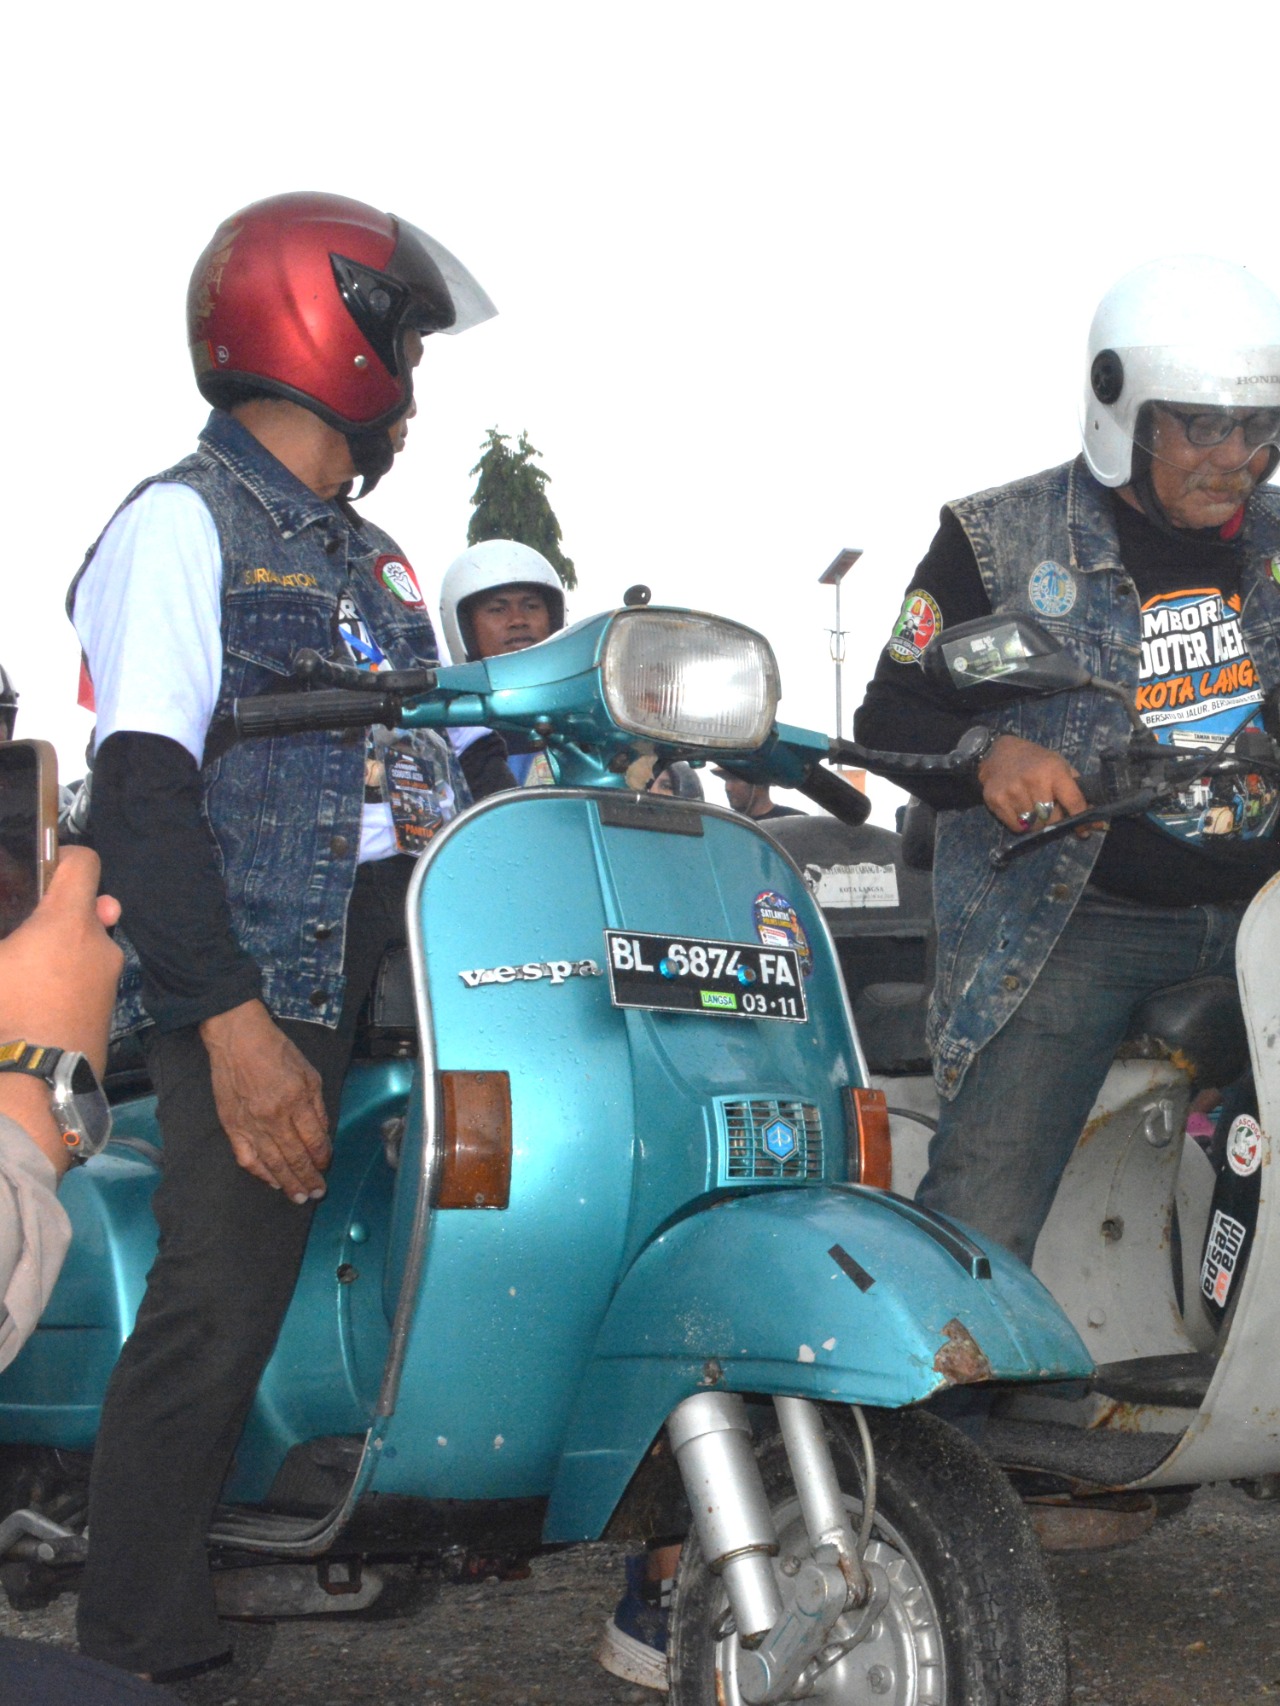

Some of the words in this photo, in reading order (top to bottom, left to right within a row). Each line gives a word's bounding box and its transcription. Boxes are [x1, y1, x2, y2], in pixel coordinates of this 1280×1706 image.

[1135, 675, 1195, 711] KOTA
[1200, 659, 1259, 698] LANG
[611, 937, 654, 972] BL
[667, 943, 745, 979] 6874
[759, 953, 796, 987] FA
[702, 994, 734, 1008] LANGSA
